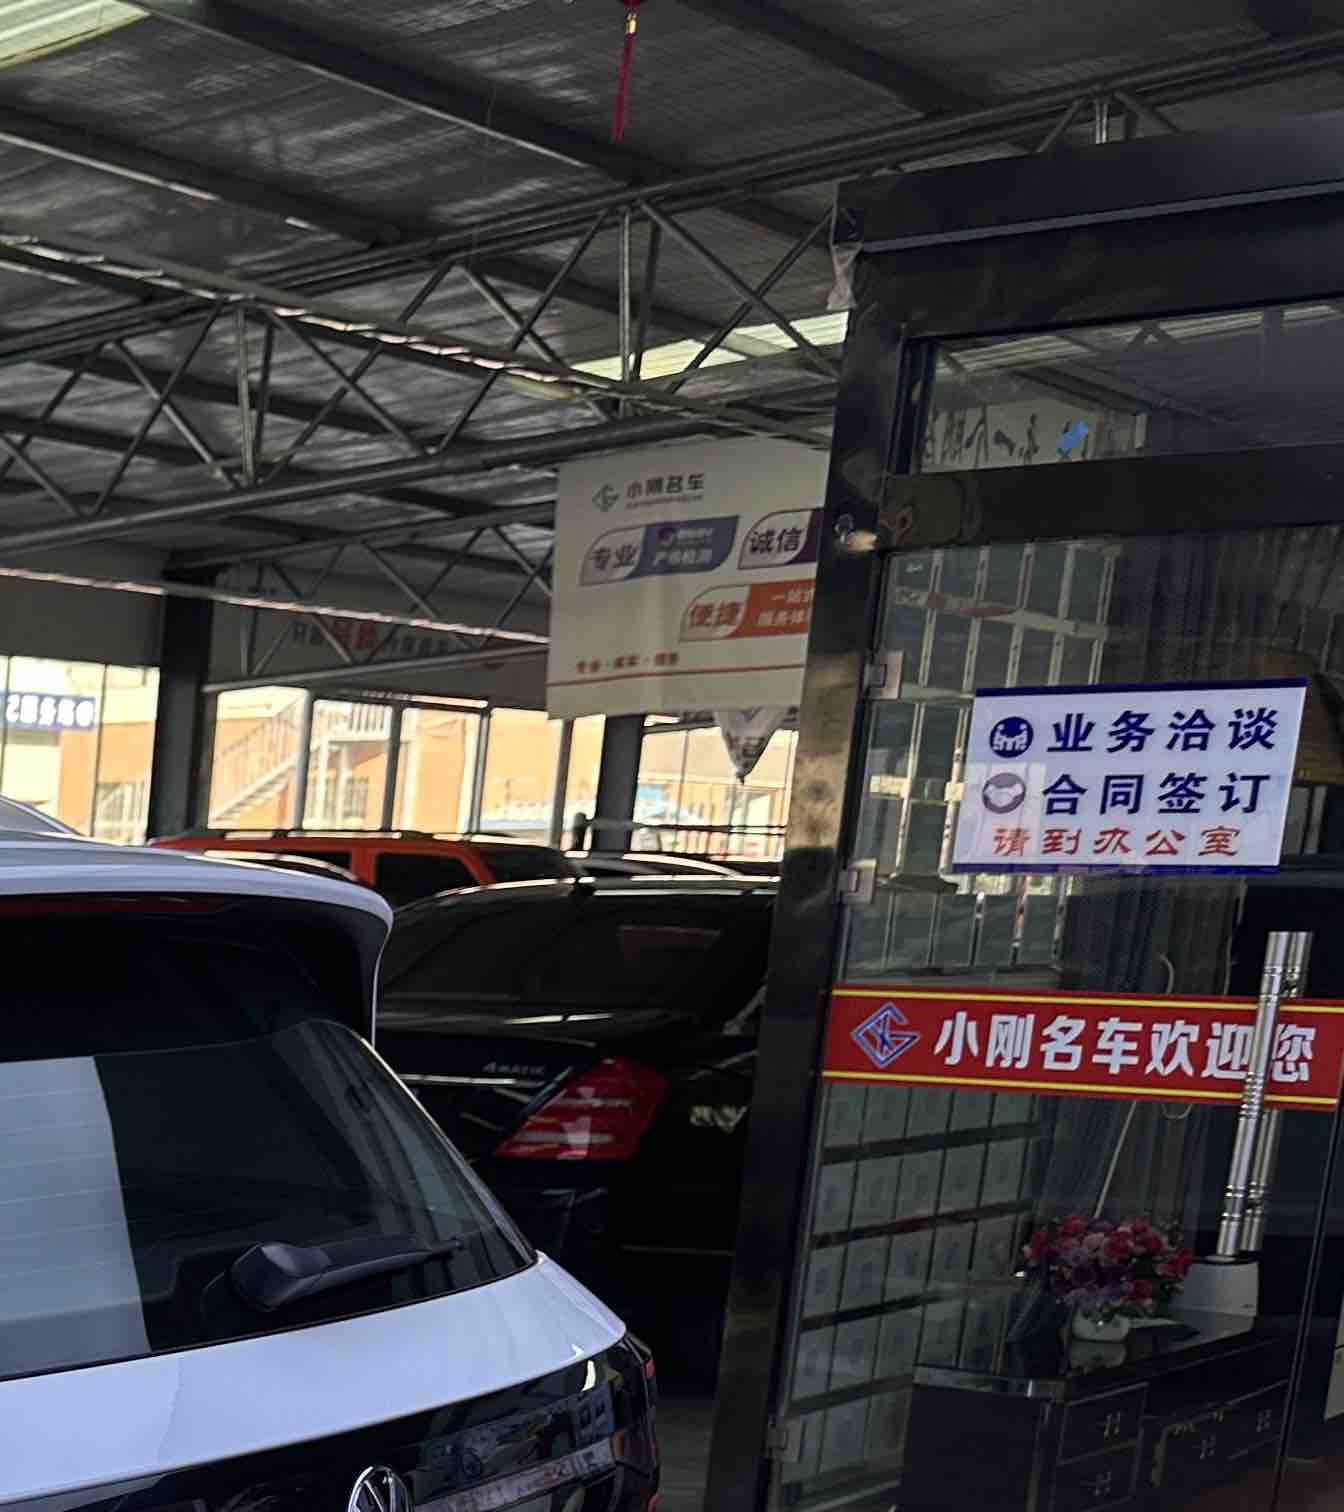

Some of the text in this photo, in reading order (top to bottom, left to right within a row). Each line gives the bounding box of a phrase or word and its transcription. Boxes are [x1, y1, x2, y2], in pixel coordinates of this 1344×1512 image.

[592, 543, 638, 570] 专业
[750, 528, 803, 553] 诚信
[1046, 706, 1281, 755] 业务洽谈
[1041, 772, 1272, 817] 合同签订
[991, 824, 1242, 858] 请到办公室
[934, 1010, 1317, 1082] 小刚名车欢迎您
